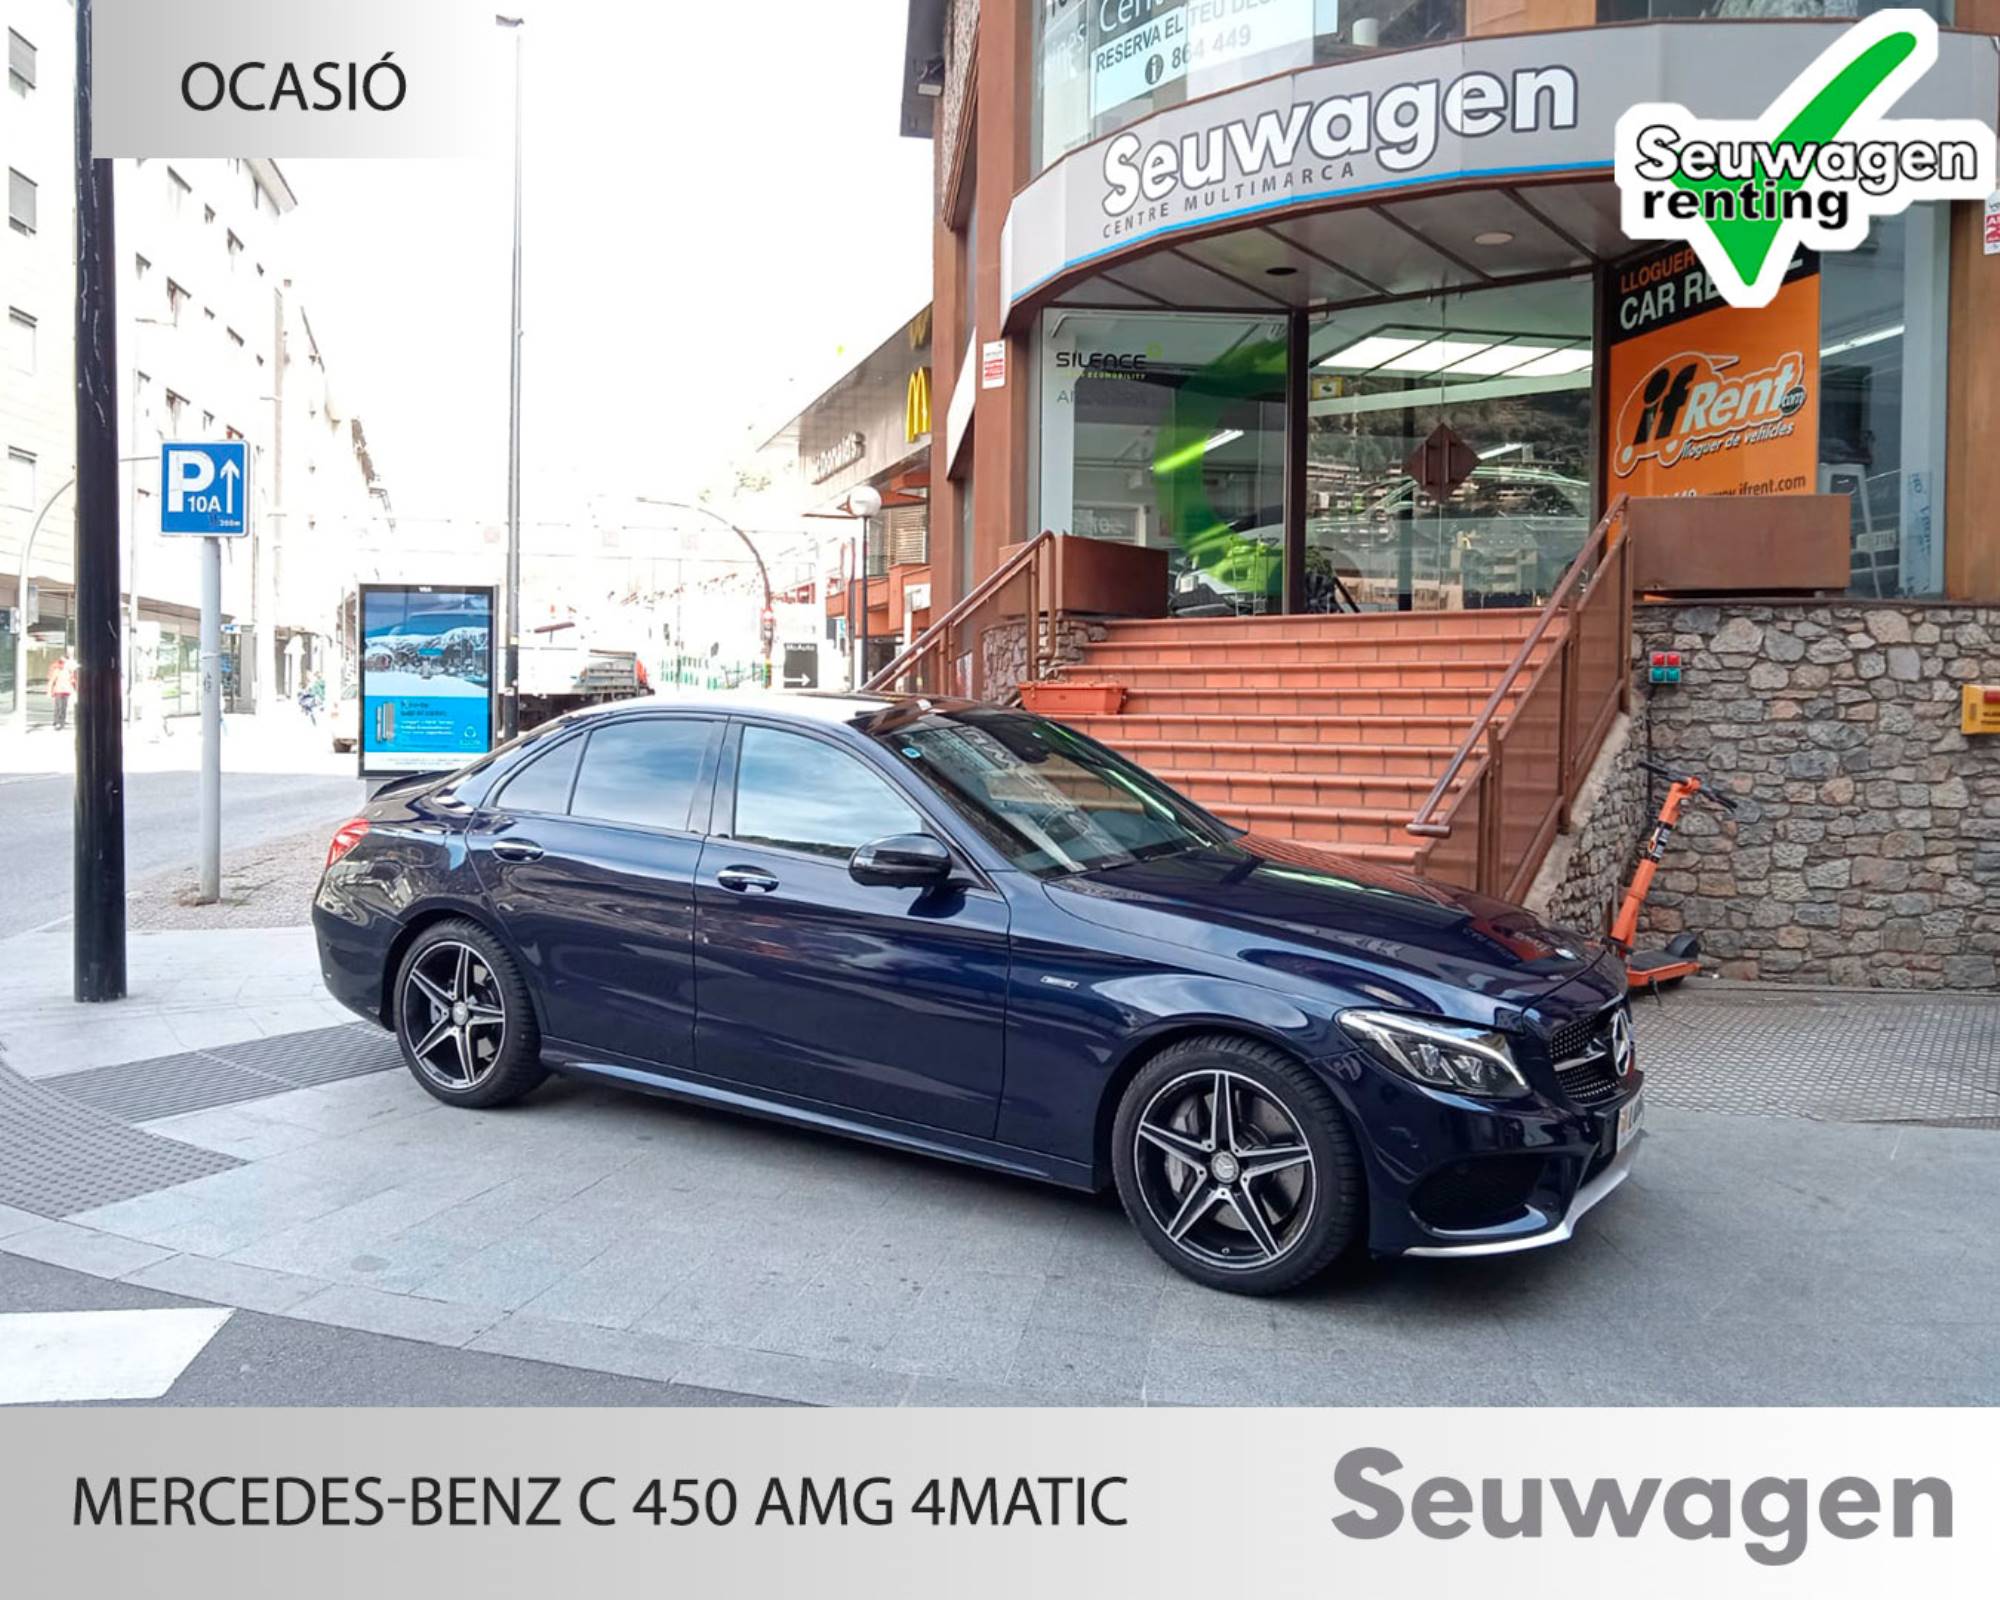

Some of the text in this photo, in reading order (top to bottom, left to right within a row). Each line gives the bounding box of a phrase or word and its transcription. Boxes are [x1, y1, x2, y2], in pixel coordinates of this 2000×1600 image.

[1096, 27, 1161, 73] RESERVA
[1166, 13, 1184, 38] EL
[1212, 24, 1251, 53] 449
[1101, 64, 1577, 217] Seuwagen
[1103, 162, 1355, 238] CENTRE MULTIMARCA
[1621, 249, 1696, 294] LLOGUER
[1620, 281, 1675, 331] CAR
[1744, 421, 1794, 446] vehicles
[168, 450, 215, 512] P
[188, 495, 221, 512] 10A
